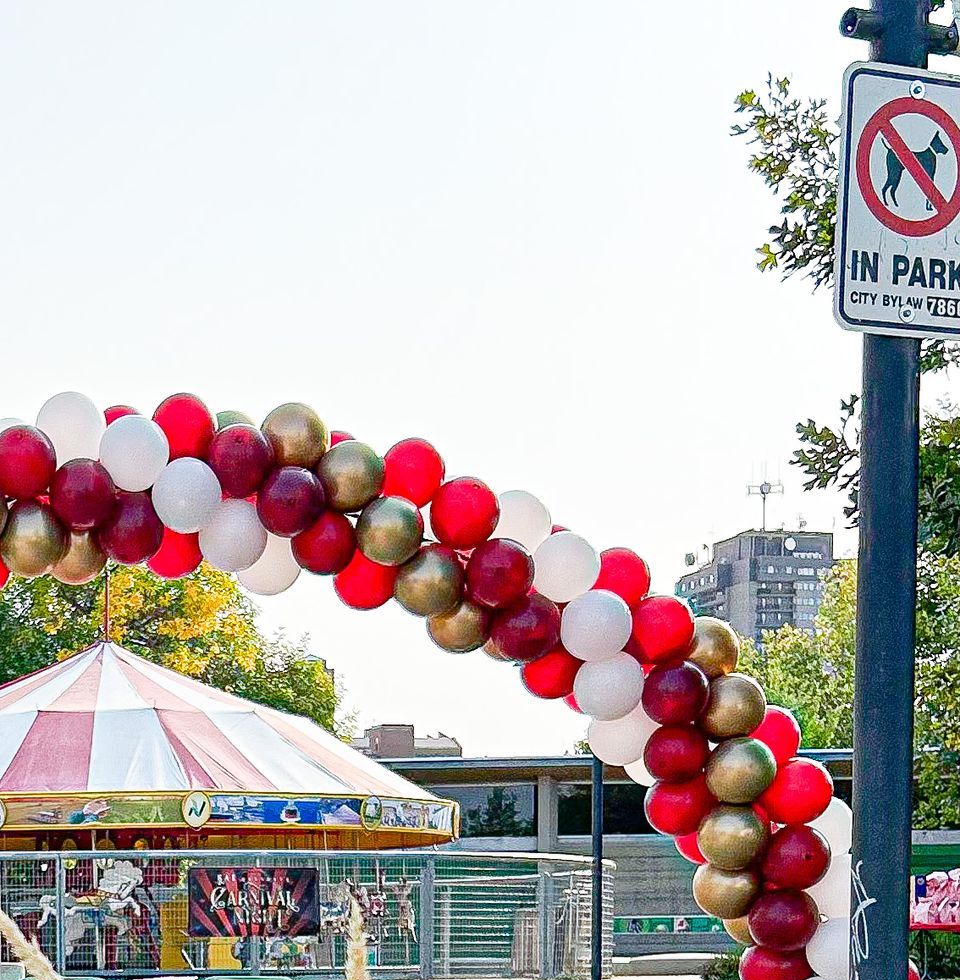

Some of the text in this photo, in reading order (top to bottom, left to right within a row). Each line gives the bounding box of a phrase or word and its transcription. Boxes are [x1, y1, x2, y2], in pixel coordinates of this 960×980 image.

[851, 249, 879, 283] IN
[850, 290, 878, 305] CITY
[882, 294, 924, 310] BYLAW
[209, 886, 300, 913] CARNIVAL
